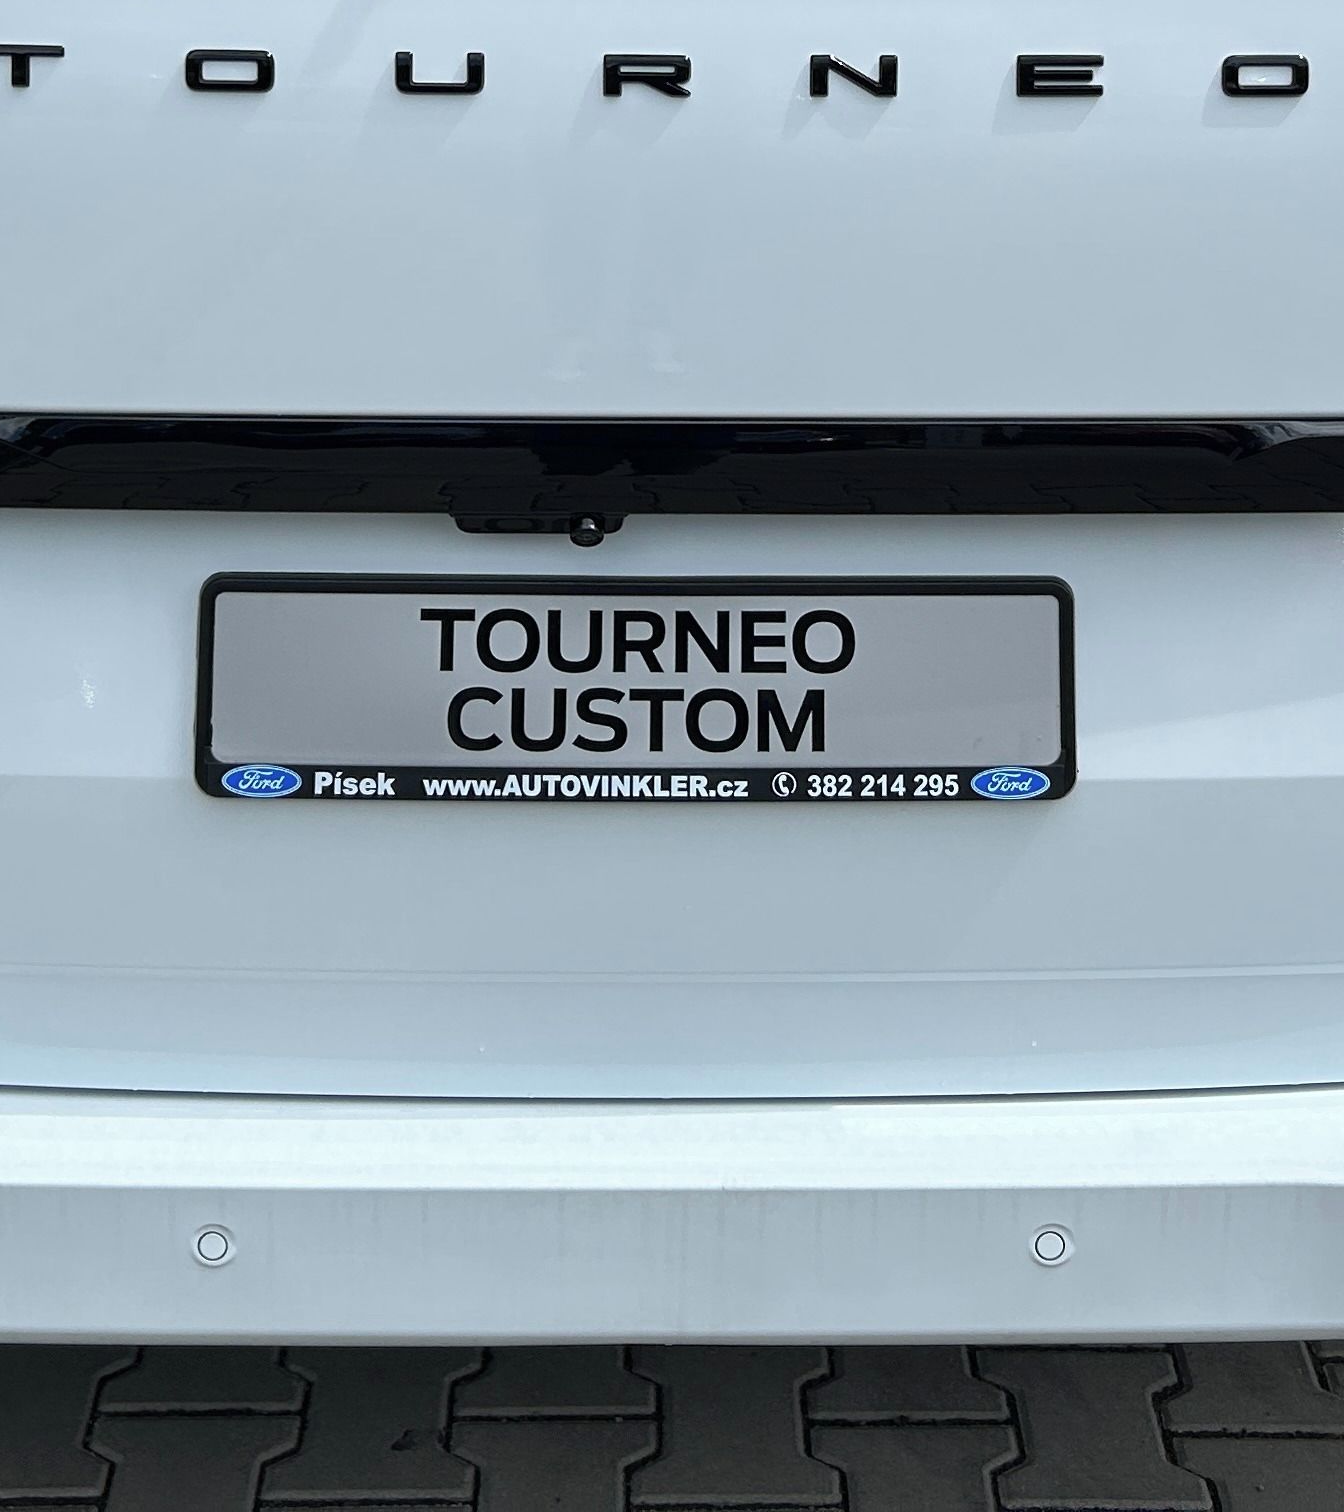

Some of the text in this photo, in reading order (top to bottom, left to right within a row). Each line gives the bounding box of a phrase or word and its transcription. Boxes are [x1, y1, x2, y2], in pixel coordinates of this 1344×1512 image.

[420, 608, 856, 675] TOURNEO
[447, 686, 825, 753] CUSTOM
[238, 769, 1032, 798] Ford Písek www.AUTOVINKLER.cz 382 214 295 Ford
